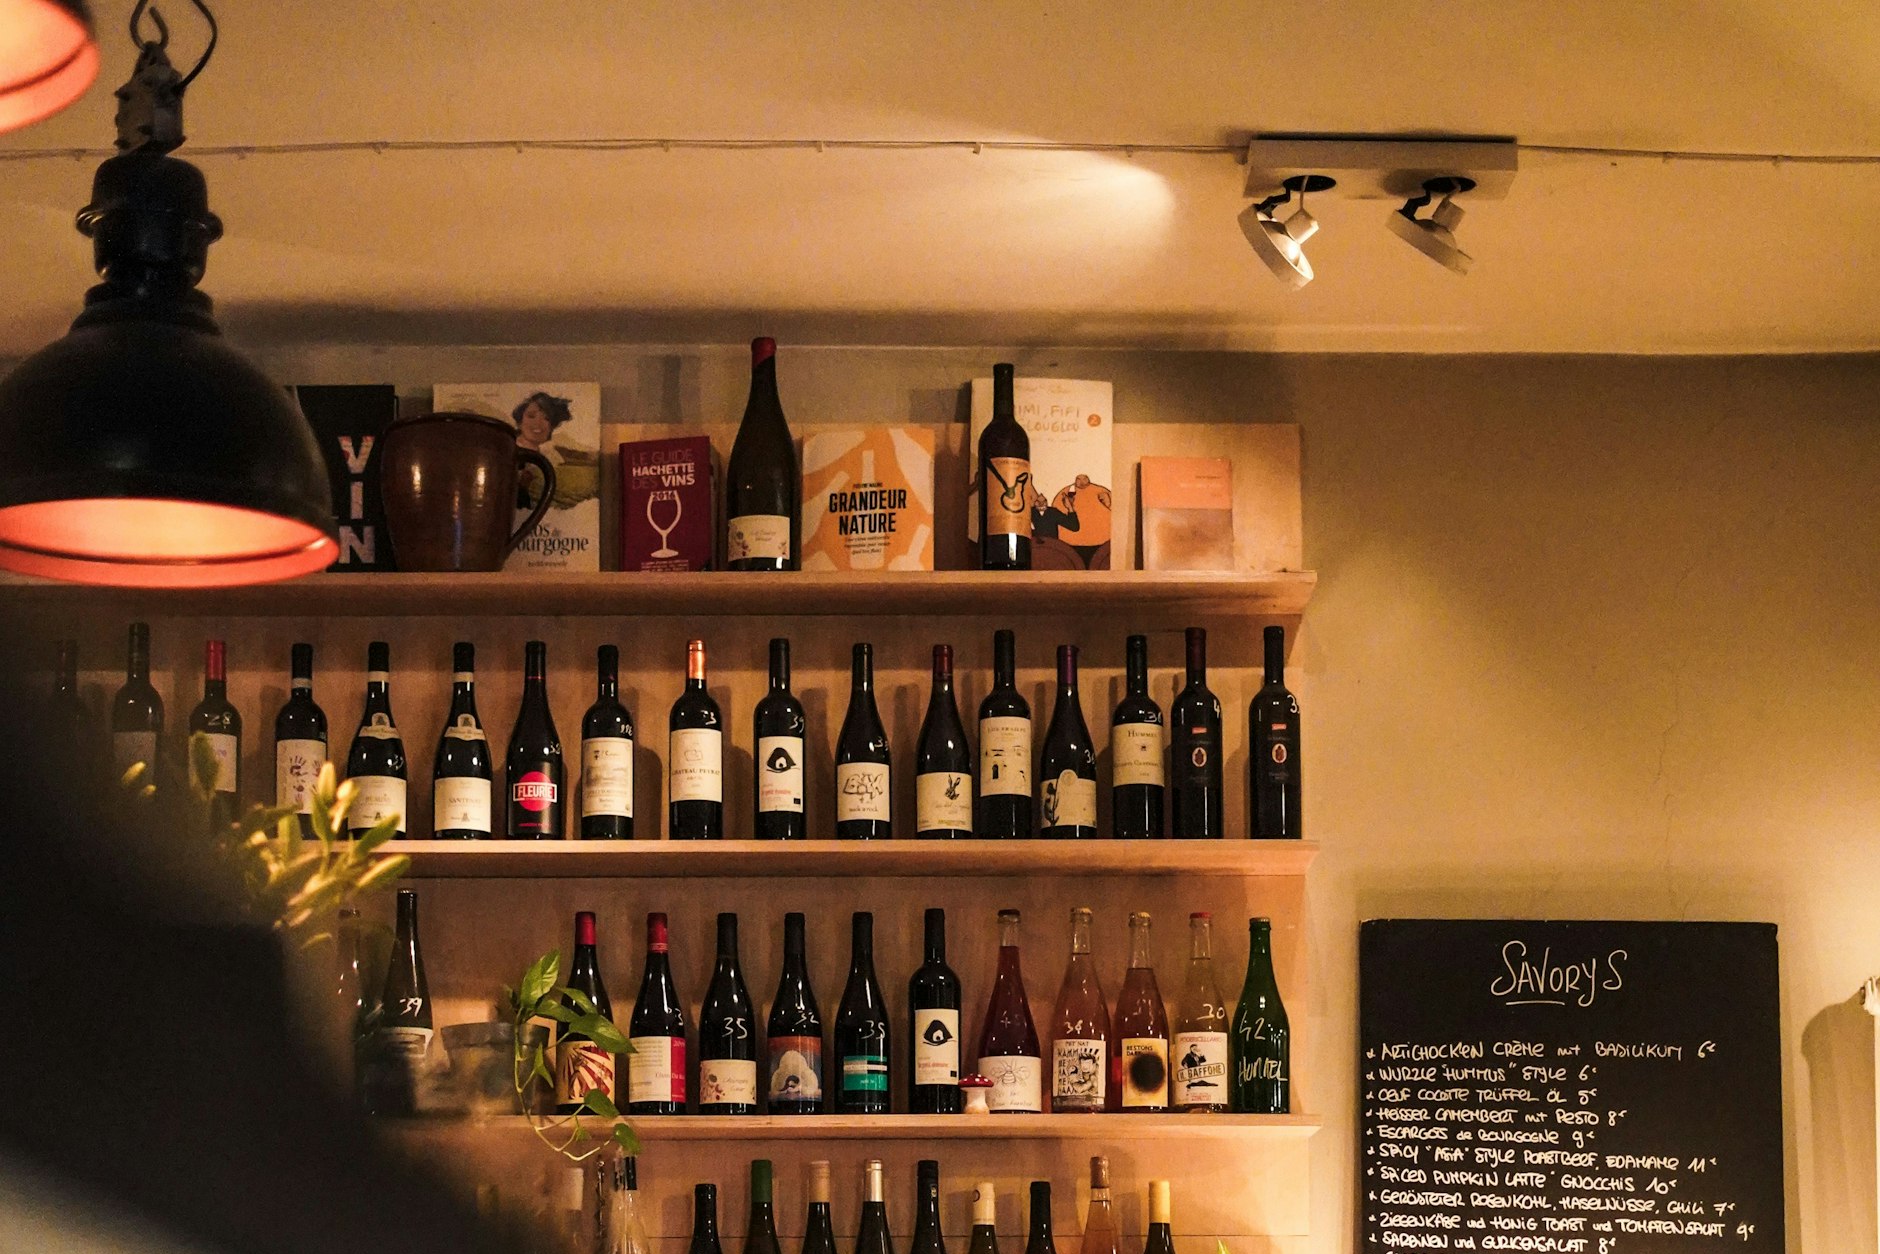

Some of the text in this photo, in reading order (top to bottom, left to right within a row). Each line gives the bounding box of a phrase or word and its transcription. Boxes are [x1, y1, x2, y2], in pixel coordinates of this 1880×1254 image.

[651, 449, 694, 464] GUIDE
[632, 462, 695, 477] HACHETTE
[661, 474, 696, 487] VINS
[829, 489, 907, 513] GRANDEUR
[838, 512, 896, 536] NATURE
[516, 536, 589, 556] ourgogne
[517, 784, 554, 799] FLEURIE
